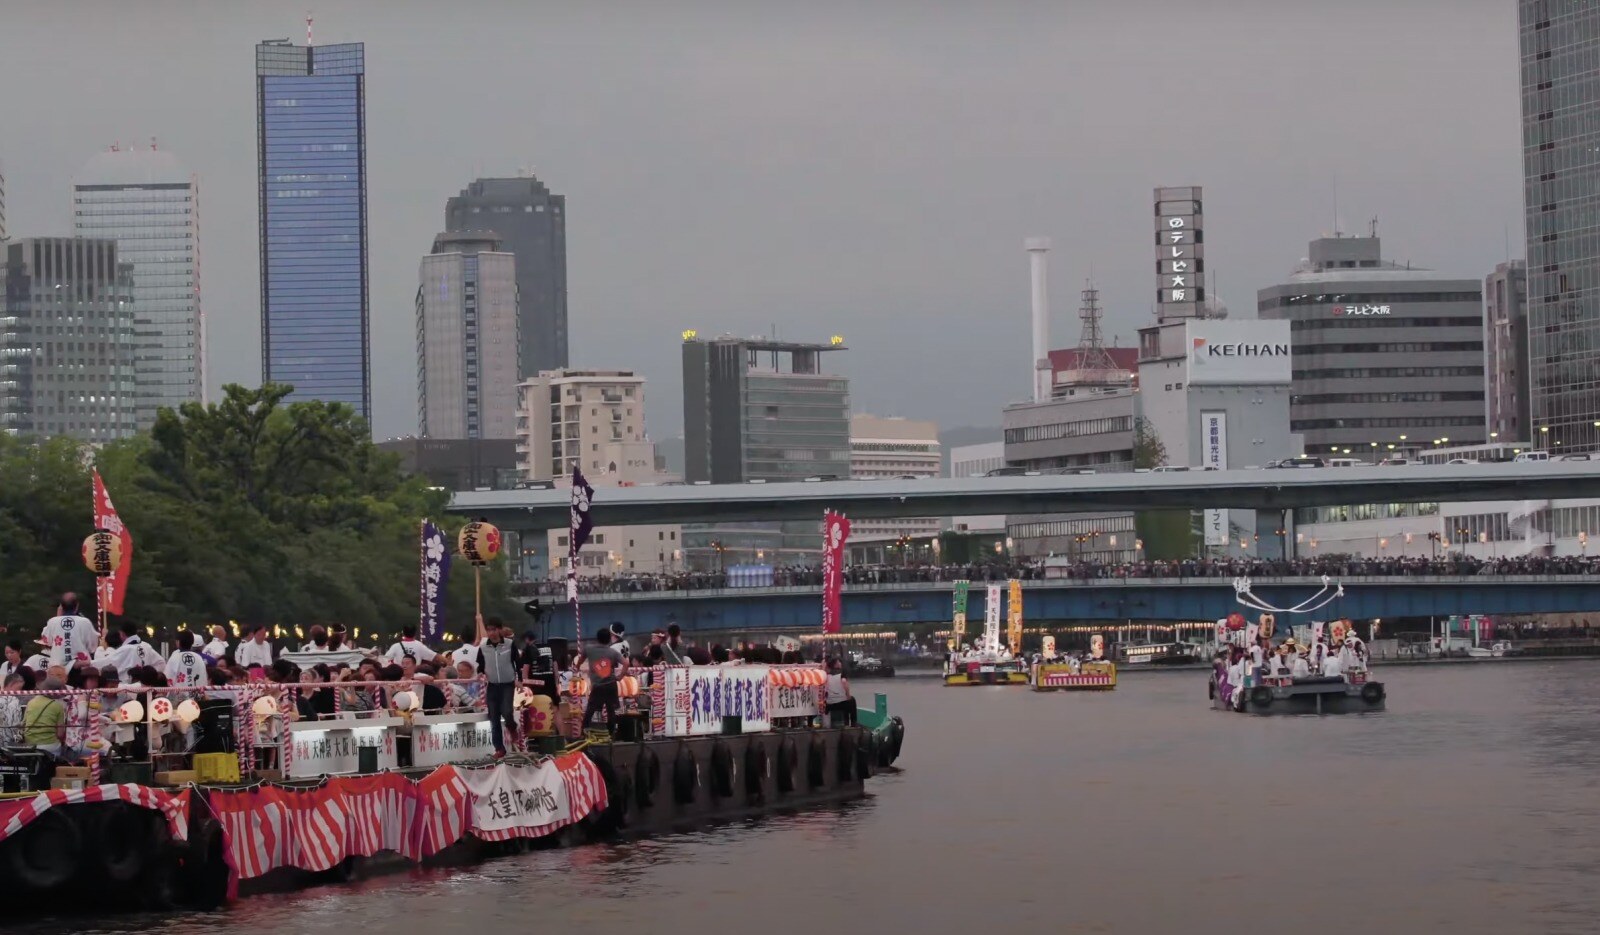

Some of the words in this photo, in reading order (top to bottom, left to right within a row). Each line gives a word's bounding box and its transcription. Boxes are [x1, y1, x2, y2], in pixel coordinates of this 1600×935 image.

[1345, 304, 1391, 316] テレビ大阪
[313, 737, 332, 760] 天神祭
[443, 730, 459, 750] 天神祭
